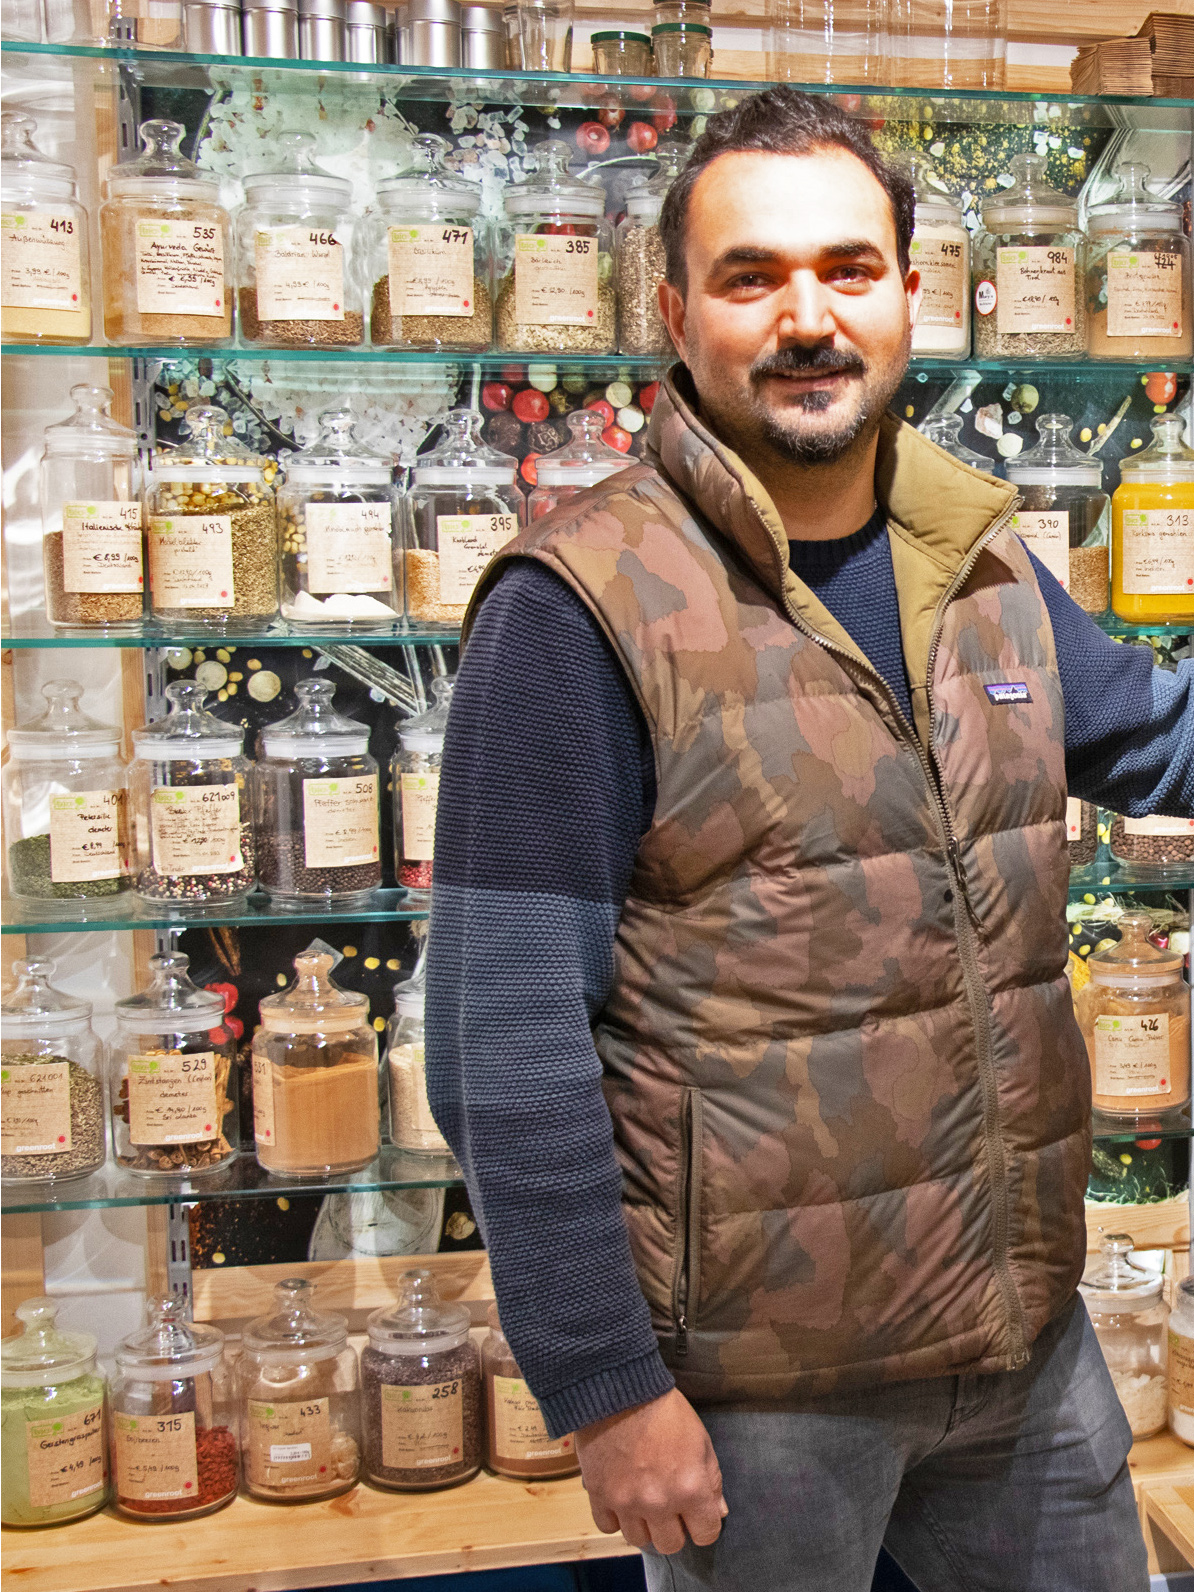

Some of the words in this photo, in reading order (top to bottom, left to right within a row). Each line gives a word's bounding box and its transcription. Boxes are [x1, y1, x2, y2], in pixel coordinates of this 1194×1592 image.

[50, 219, 74, 234] 413
[193, 226, 216, 239] 535
[309, 232, 337, 246] 466
[442, 229, 468, 244] 471
[565, 240, 591, 254] 385
[941, 243, 961, 258] 475
[1047, 251, 1067, 264] 984
[549, 315, 586, 324] greenroot
[923, 315, 955, 324] greenroot
[1031, 323, 1065, 331] greenroot
[1141, 326, 1172, 334] greenroot
[119, 508, 138, 520] 415
[361, 509, 380, 520] 494
[490, 516, 512, 532] 395
[1038, 518, 1060, 530] 390
[1166, 514, 1190, 527] 313
[202, 523, 224, 534] 493
[1150, 584, 1186, 593] greenroot
[993, 690, 1028, 702] patagonia
[355, 783, 373, 794] 508
[103, 794, 123, 806] 401
[202, 791, 236, 803] 621009
[1140, 1018, 1159, 1032] 426
[181, 1059, 207, 1073] 529
[29, 1073, 63, 1083] 621001
[138, 1075, 182, 1089] Zimtstangen
[1125, 1084, 1159, 1093] greenroot
[164, 1132, 204, 1142] greenroot
[16, 1143, 56, 1153] greenroot
[432, 1382, 459, 1400] 258
[300, 1404, 321, 1417] 433
[156, 1419, 182, 1433] 315
[526, 1447, 561, 1458] greenroot
[416, 1455, 451, 1466] greenroot
[145, 1489, 183, 1498] greenroot
